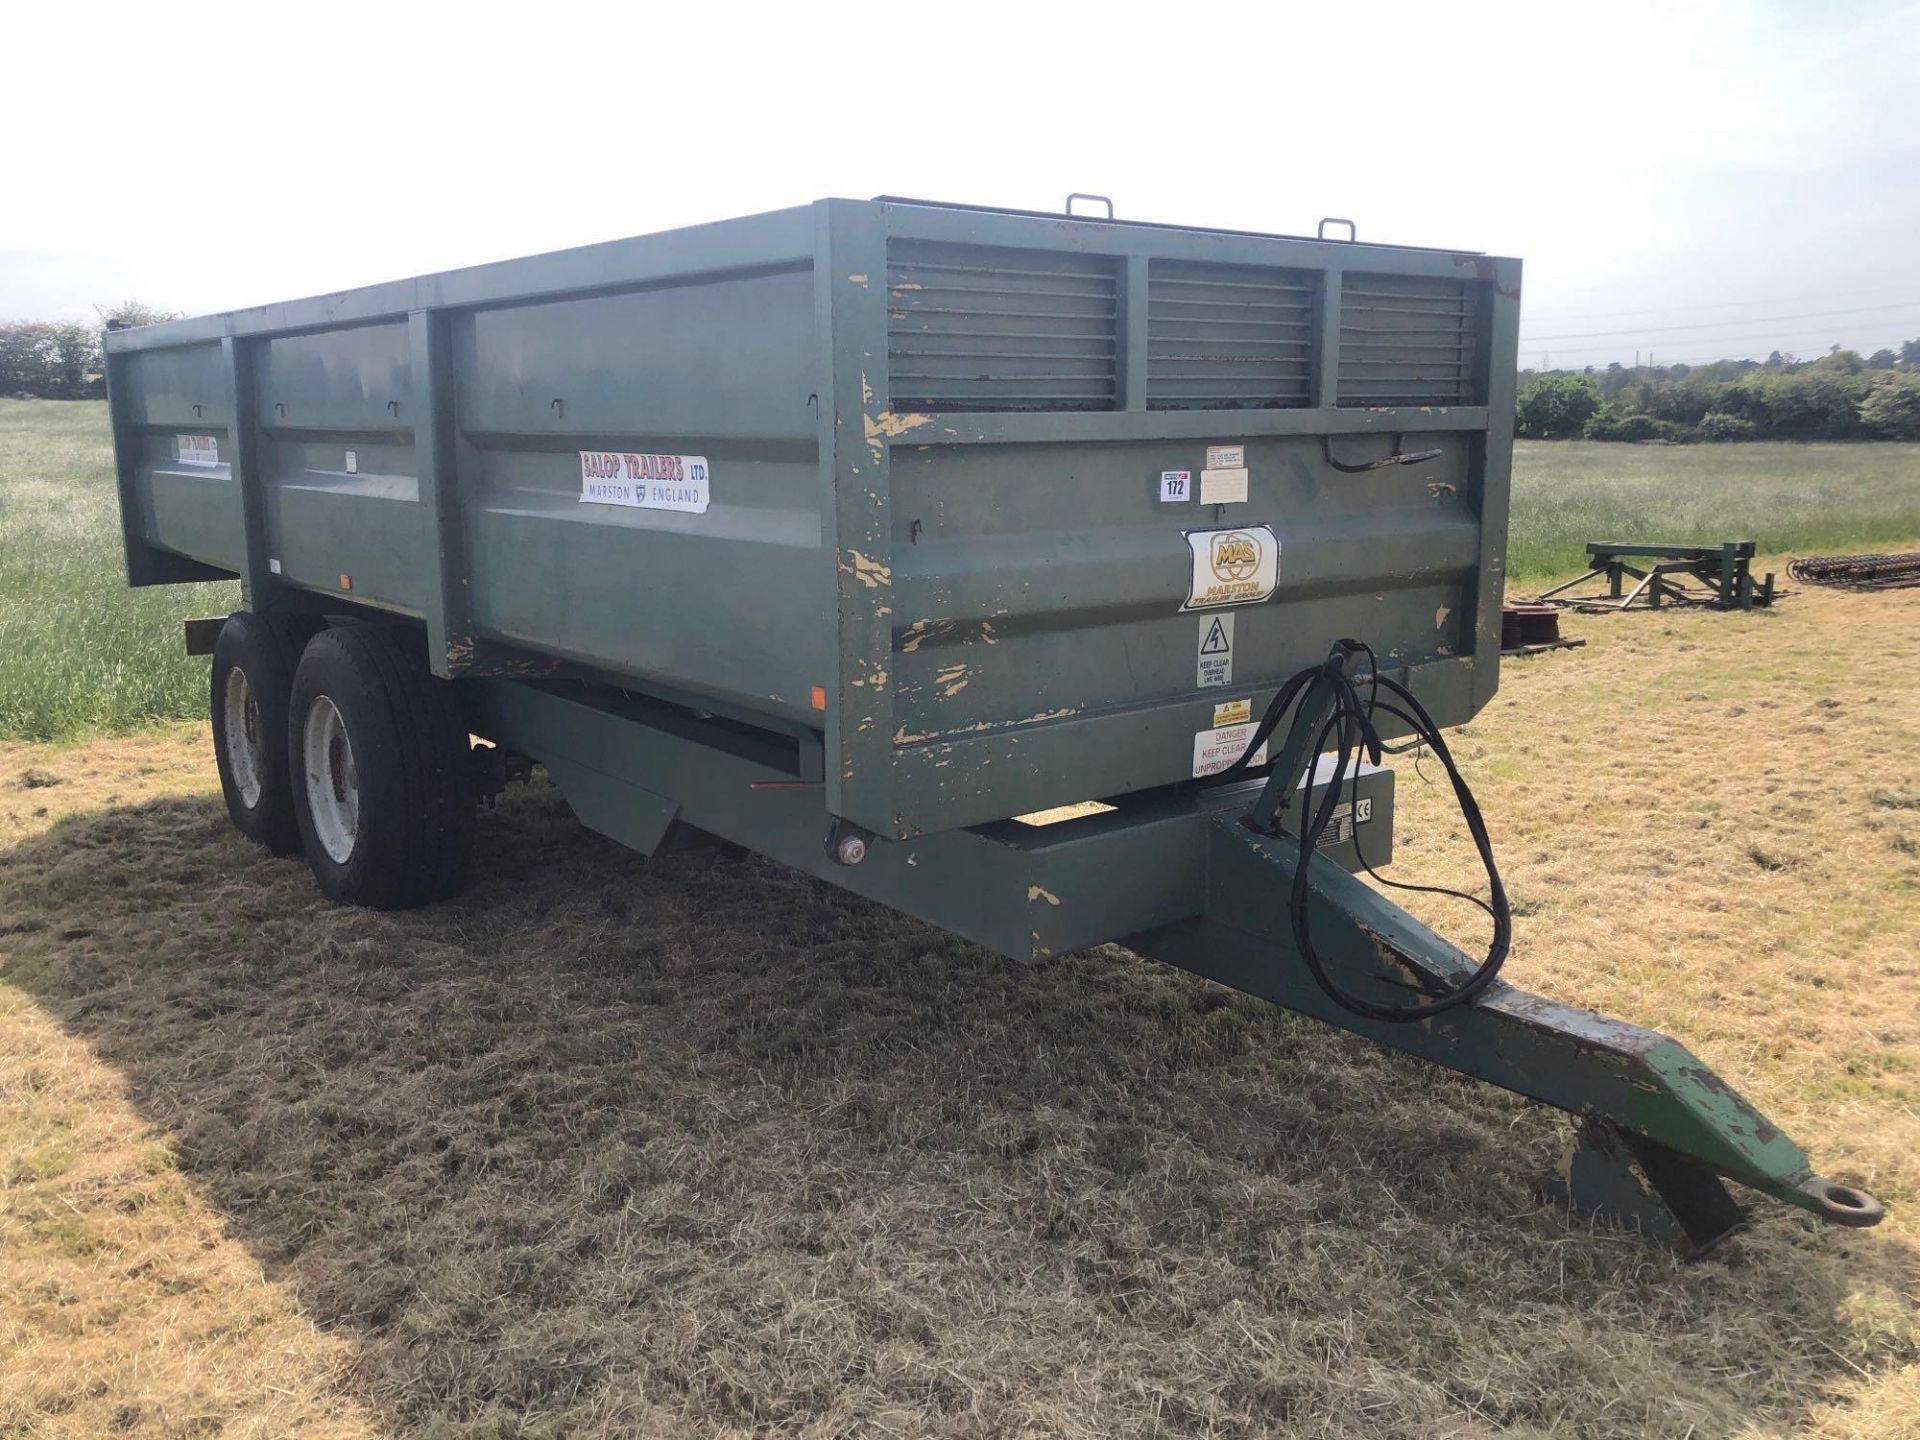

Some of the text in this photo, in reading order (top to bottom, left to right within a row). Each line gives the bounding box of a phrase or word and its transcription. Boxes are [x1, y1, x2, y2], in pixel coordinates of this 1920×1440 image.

[584, 454, 621, 479] SALOP
[624, 455, 685, 482] TRAILERS
[588, 484, 630, 500] MARSTON
[1167, 480, 1184, 495] 172
[1216, 543, 1256, 565] MAS
[1207, 581, 1260, 596] MARSTON
[1200, 658, 1229, 669] KEEP CLEAR
[1215, 728, 1248, 741] DANGER
[1202, 743, 1247, 759] KEEP CLEAR
[1358, 802, 1369, 817] CE
